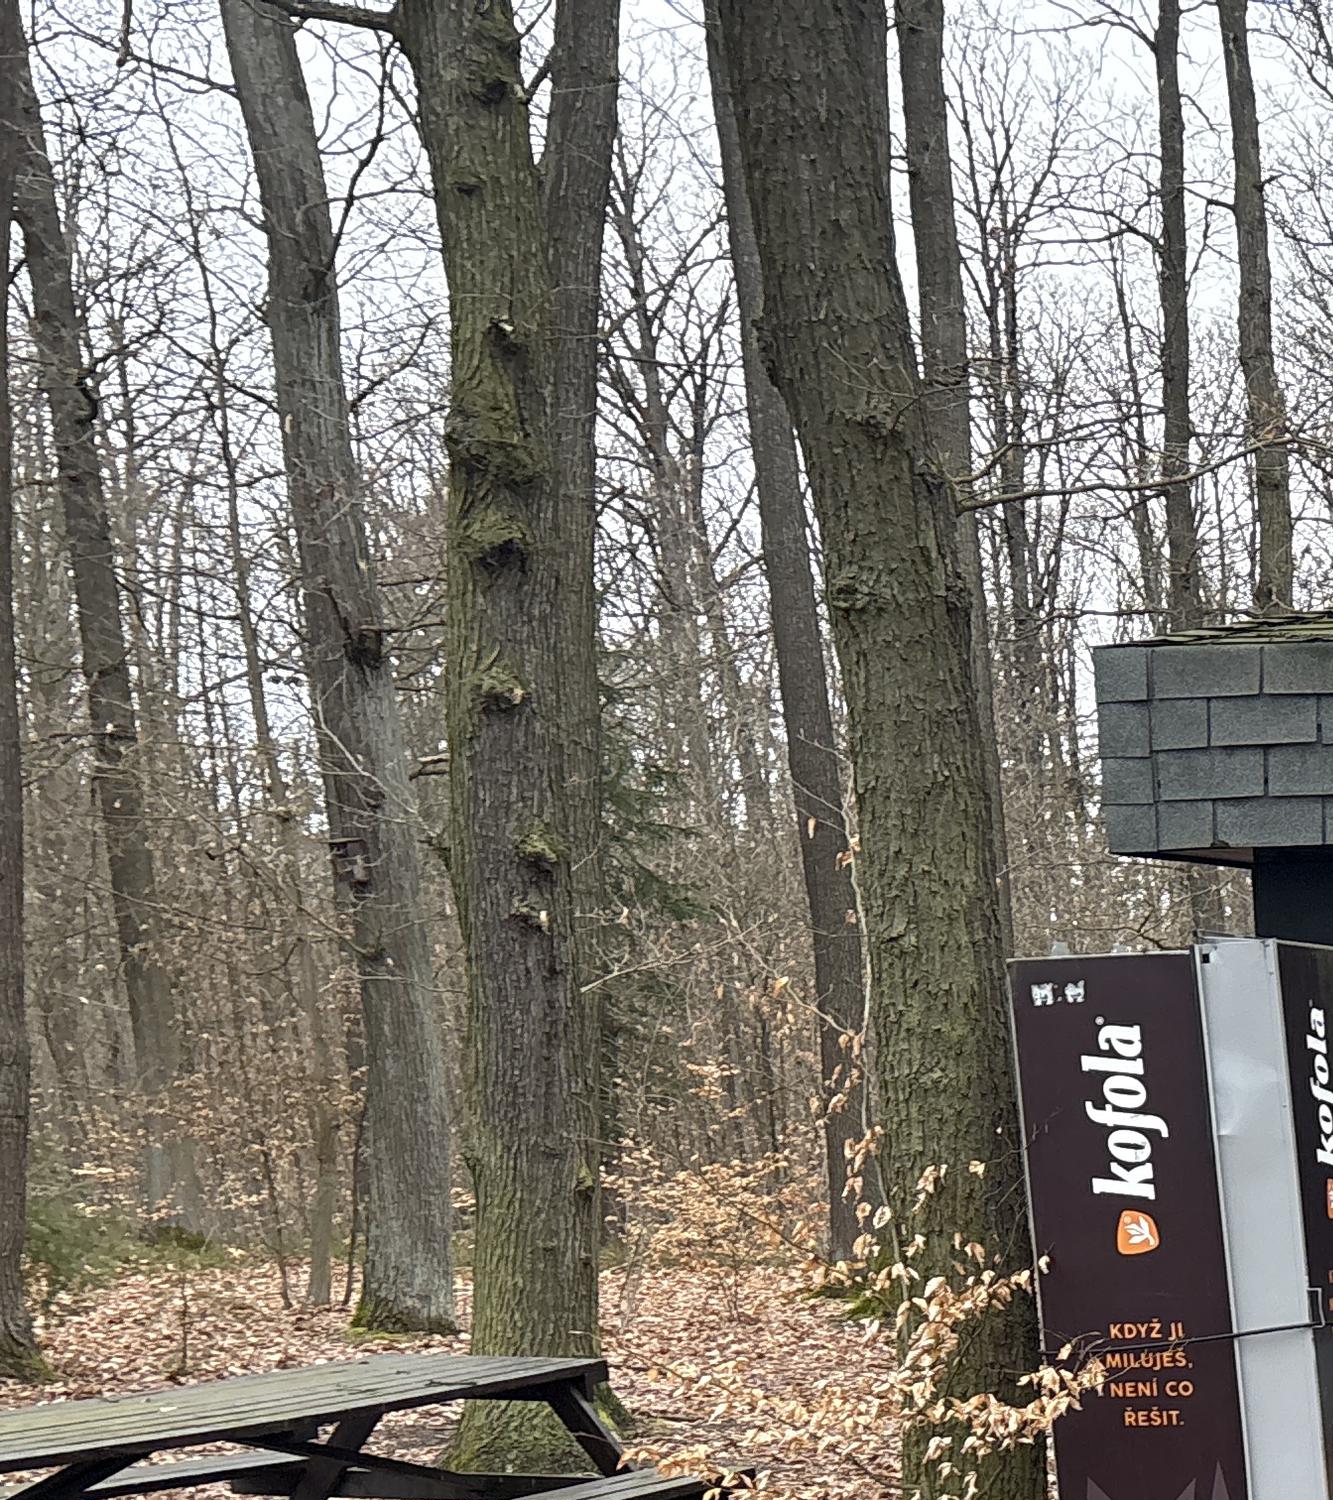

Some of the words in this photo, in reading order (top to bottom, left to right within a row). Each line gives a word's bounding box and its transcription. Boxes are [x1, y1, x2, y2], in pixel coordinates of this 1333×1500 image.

[1081, 1024, 1169, 1200] kofola
[1109, 1317, 1162, 1339] KDYŽ
[1168, 1322, 1184, 1341] JI
[1110, 1377, 1158, 1398] NENÍ
[1165, 1381, 1194, 1397] CO
[1124, 1406, 1184, 1426] ŘEŠIT.
